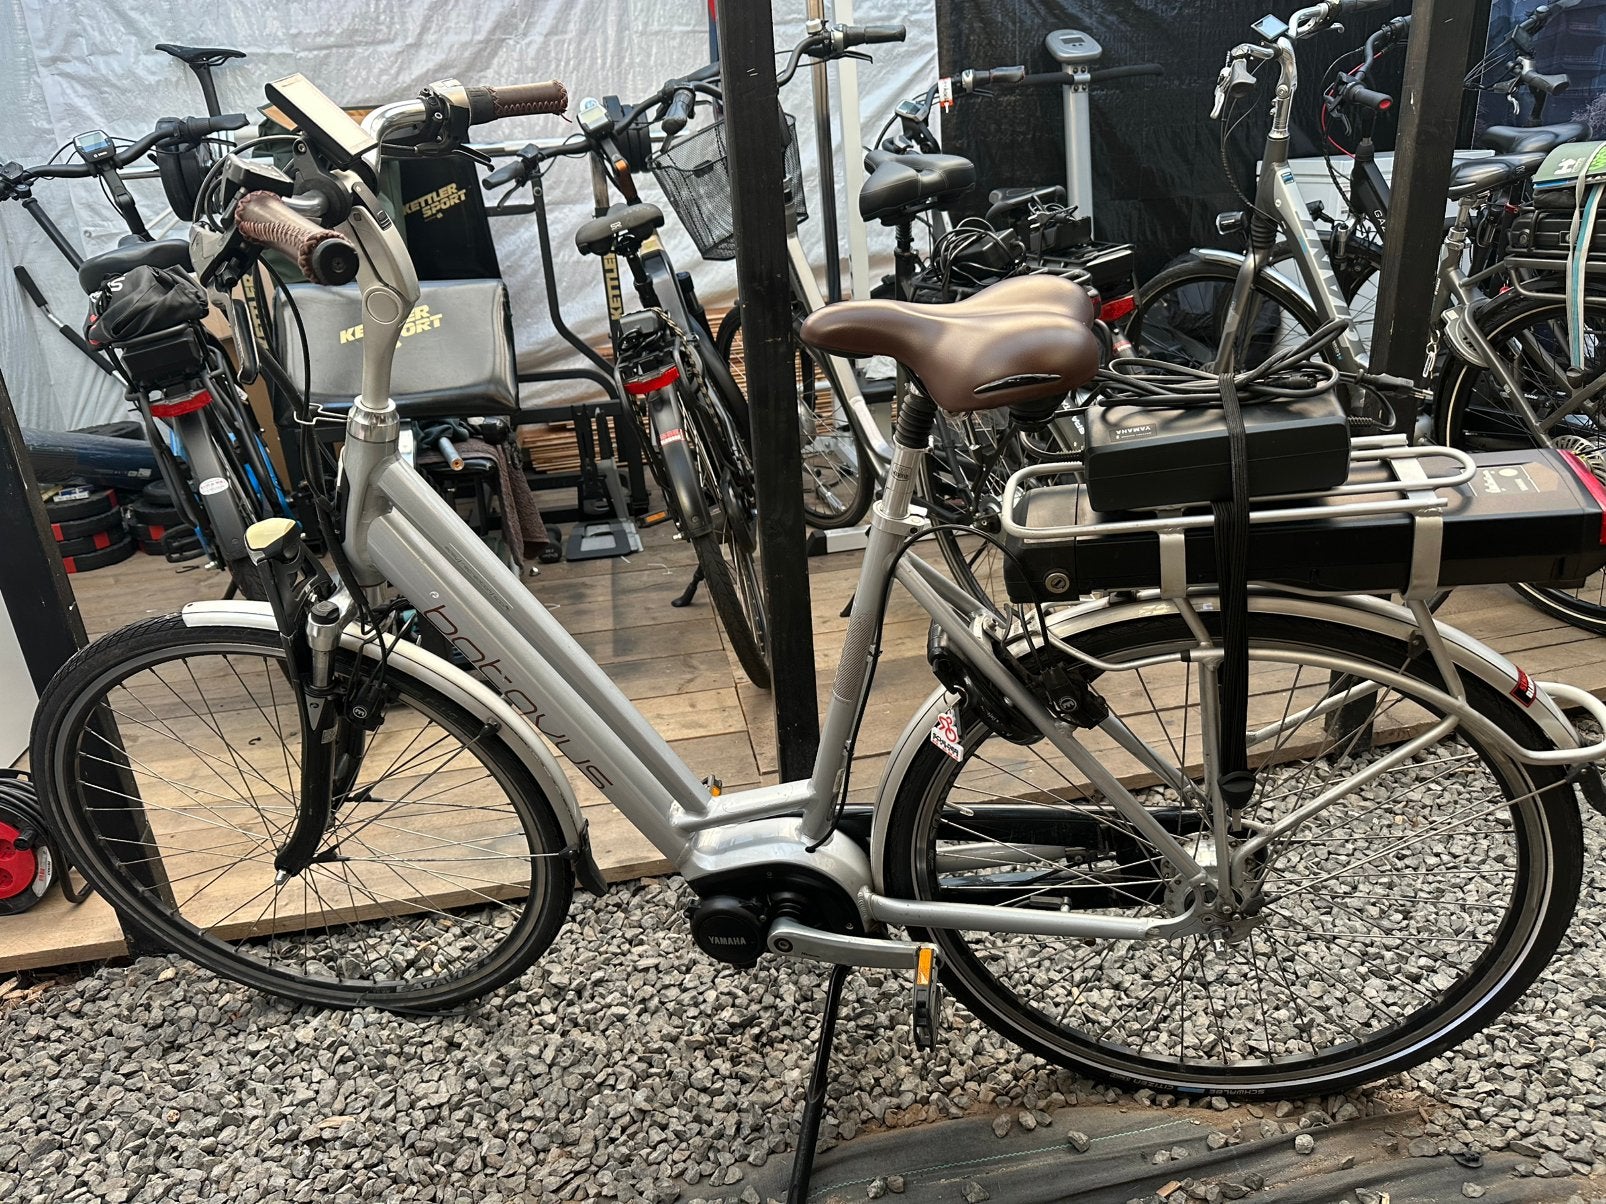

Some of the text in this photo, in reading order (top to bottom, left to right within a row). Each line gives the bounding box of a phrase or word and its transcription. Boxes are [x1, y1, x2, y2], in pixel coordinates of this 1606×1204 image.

[403, 183, 457, 215] KETTLER
[422, 189, 466, 218] SPORT
[340, 304, 430, 344] KEER
[1116, 426, 1151, 434] YAMAHA
[707, 935, 747, 945] YAMAHA
[1133, 1078, 1174, 1090] CITIZEN
